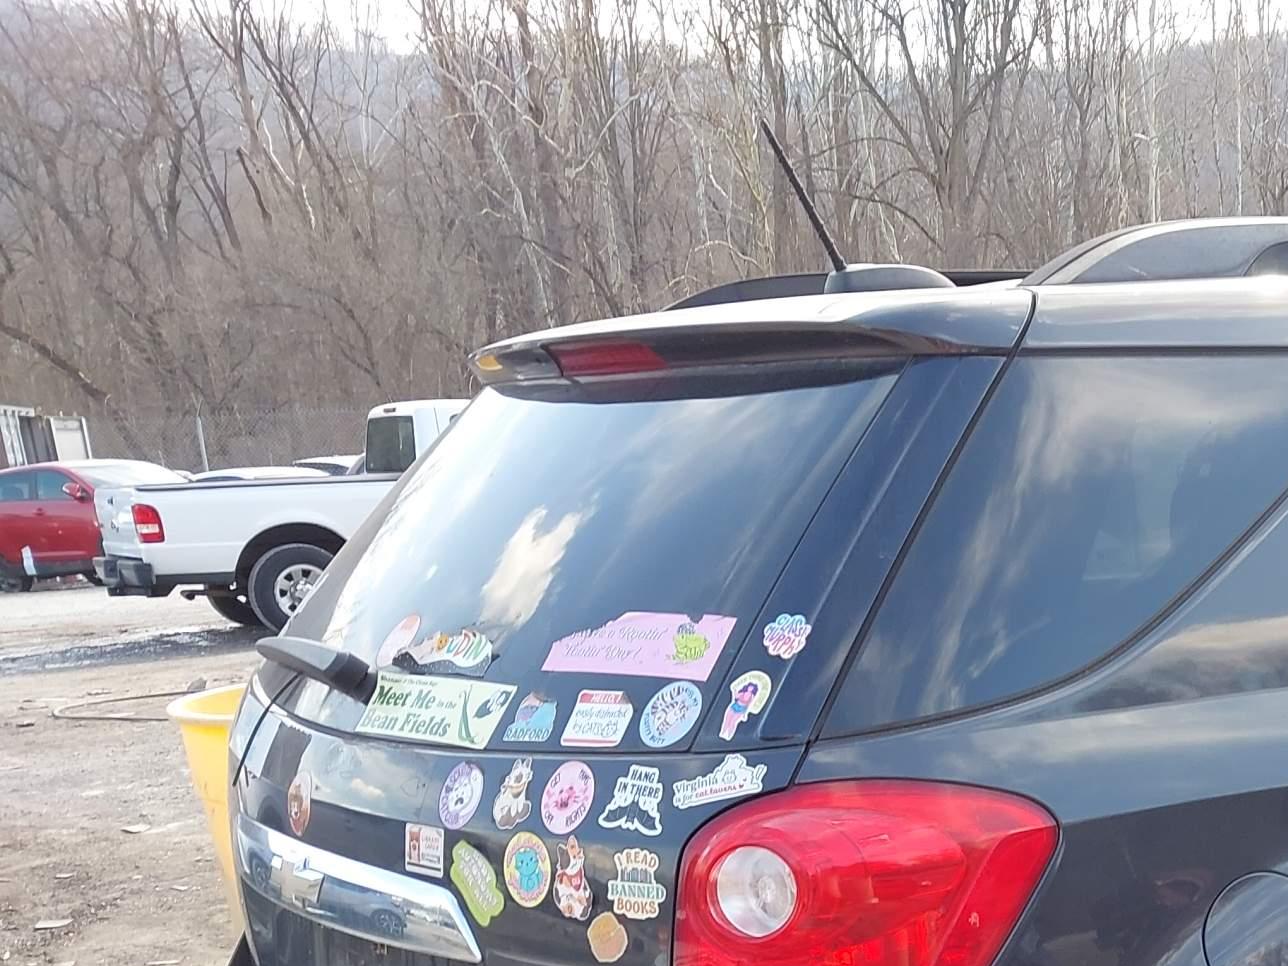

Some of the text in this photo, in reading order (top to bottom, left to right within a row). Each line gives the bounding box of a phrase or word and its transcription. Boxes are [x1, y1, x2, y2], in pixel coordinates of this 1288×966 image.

[373, 685, 412, 708] Meet
[410, 688, 436, 710] Me
[361, 708, 452, 738] Bean Fields
[505, 727, 550, 740] RADFORD
[550, 772, 561, 789] GET
[630, 769, 656, 784] HANG
[674, 774, 718, 794] Virginia
[617, 780, 661, 800] IN THERE
[616, 850, 657, 869] I READ
[610, 882, 665, 900] BANNED
[616, 898, 657, 914] BOOKS
